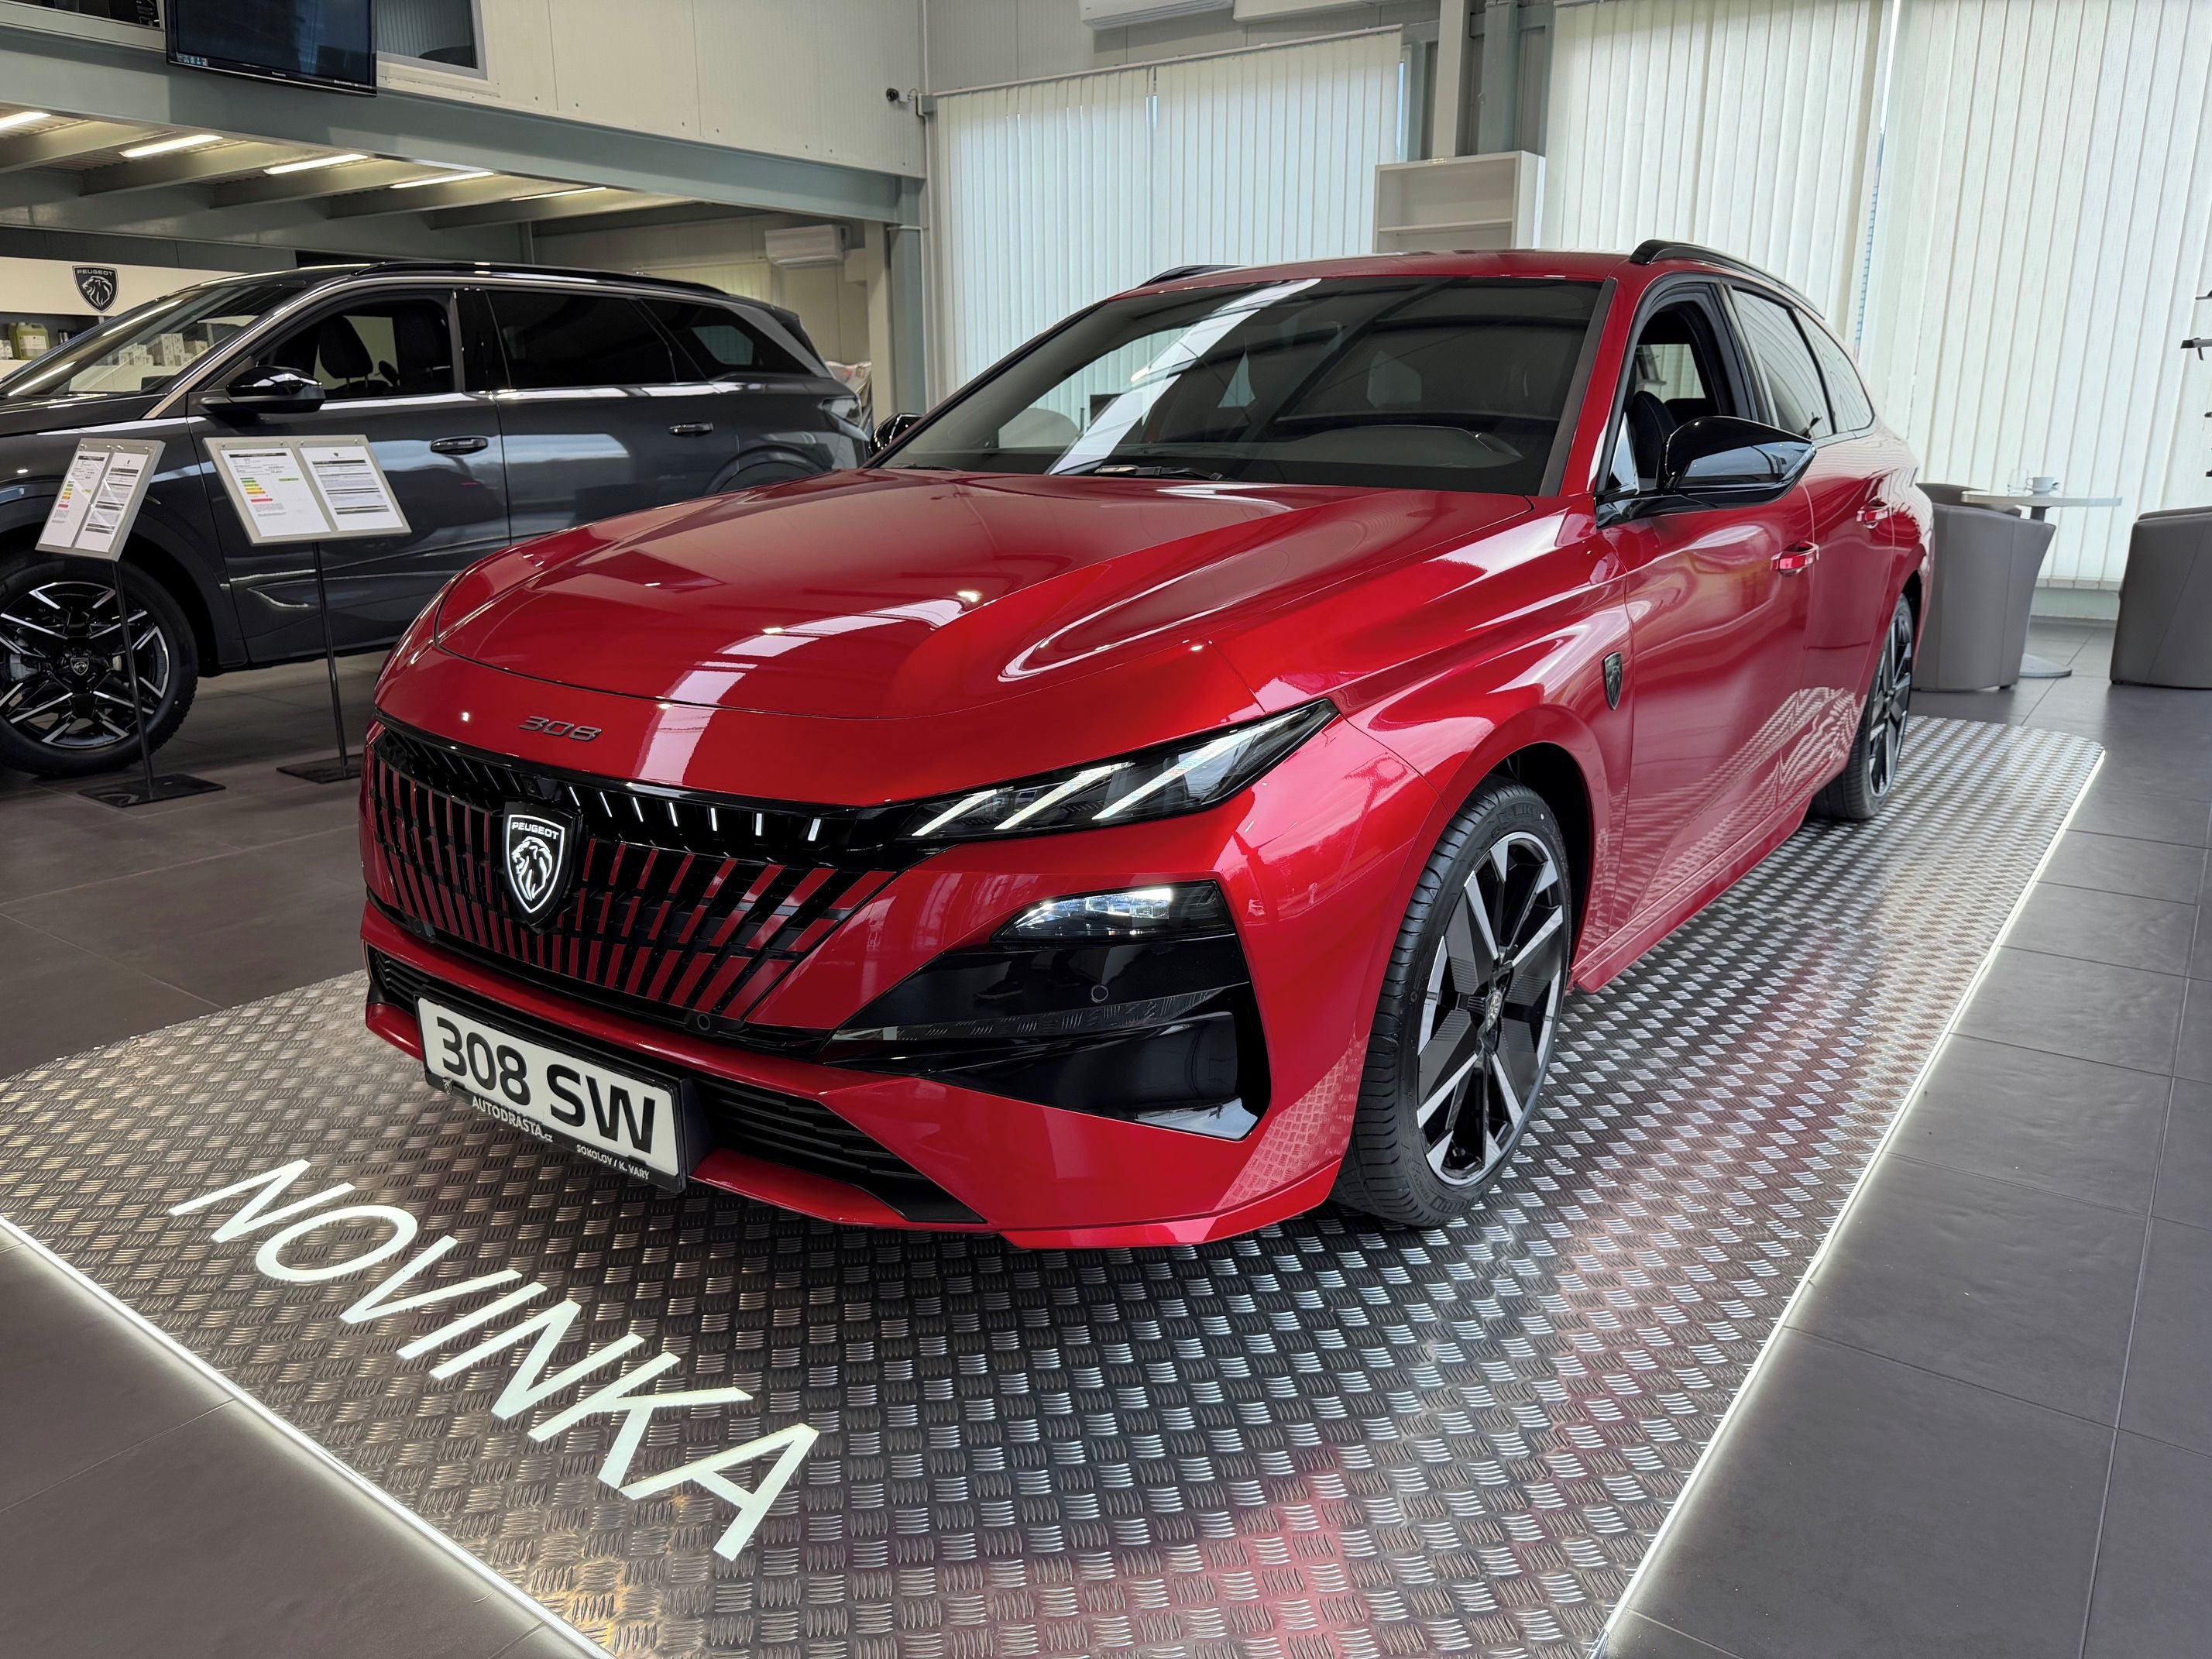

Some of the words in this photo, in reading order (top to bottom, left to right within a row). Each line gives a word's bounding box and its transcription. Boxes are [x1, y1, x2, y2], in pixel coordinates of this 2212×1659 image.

[519, 716, 602, 741] 308
[511, 822, 559, 840] PEUGEOT
[437, 1016, 531, 1106] 308
[547, 1063, 655, 1154] SW
[576, 1144, 613, 1166] SOKOLOV
[628, 1164, 649, 1180] VARY
[167, 1159, 819, 1561] NOVINKA
